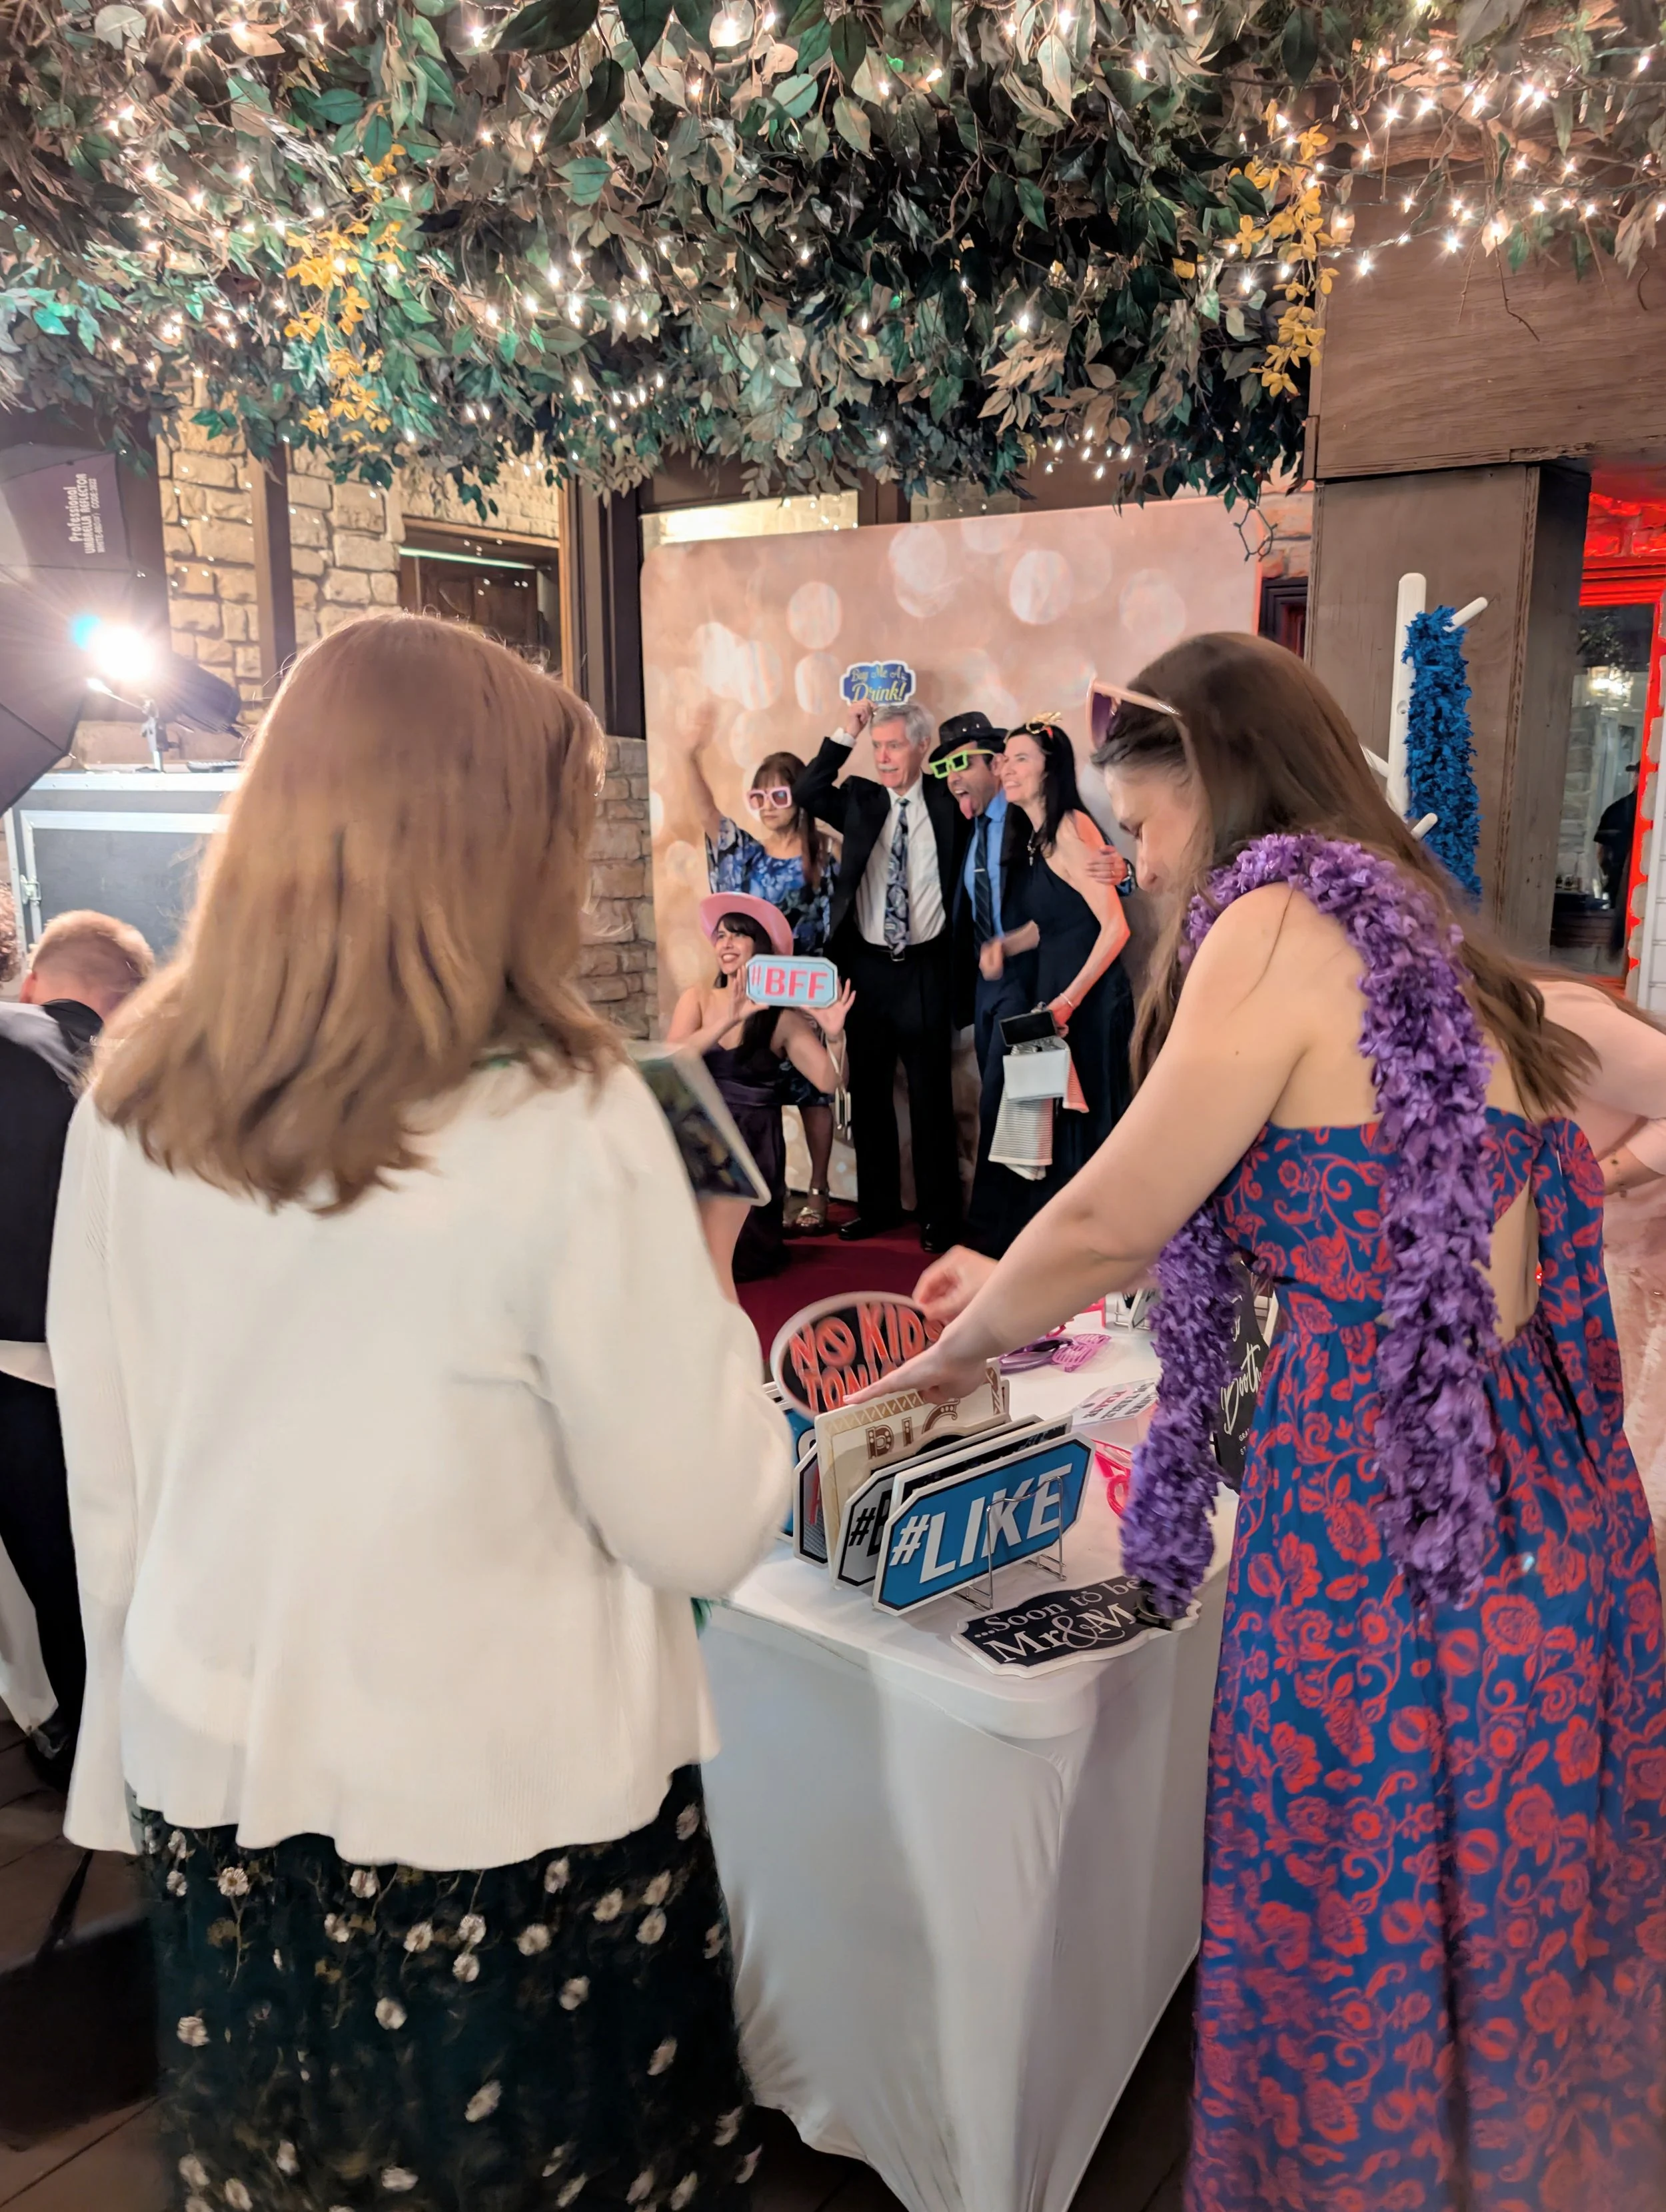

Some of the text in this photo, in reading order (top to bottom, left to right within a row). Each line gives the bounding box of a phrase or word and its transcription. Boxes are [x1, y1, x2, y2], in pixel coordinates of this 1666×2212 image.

[63, 486, 83, 542] Professional
[81, 516, 96, 554] UMBRELLA
[852, 681, 907, 702] Drink!
[789, 1317, 857, 1379] NO
[800, 1358, 897, 1413] TONI
[890, 1462, 1073, 1584] #LIKE
[1069, 1590, 1103, 1606] to
[1099, 1580, 1142, 1595] be
